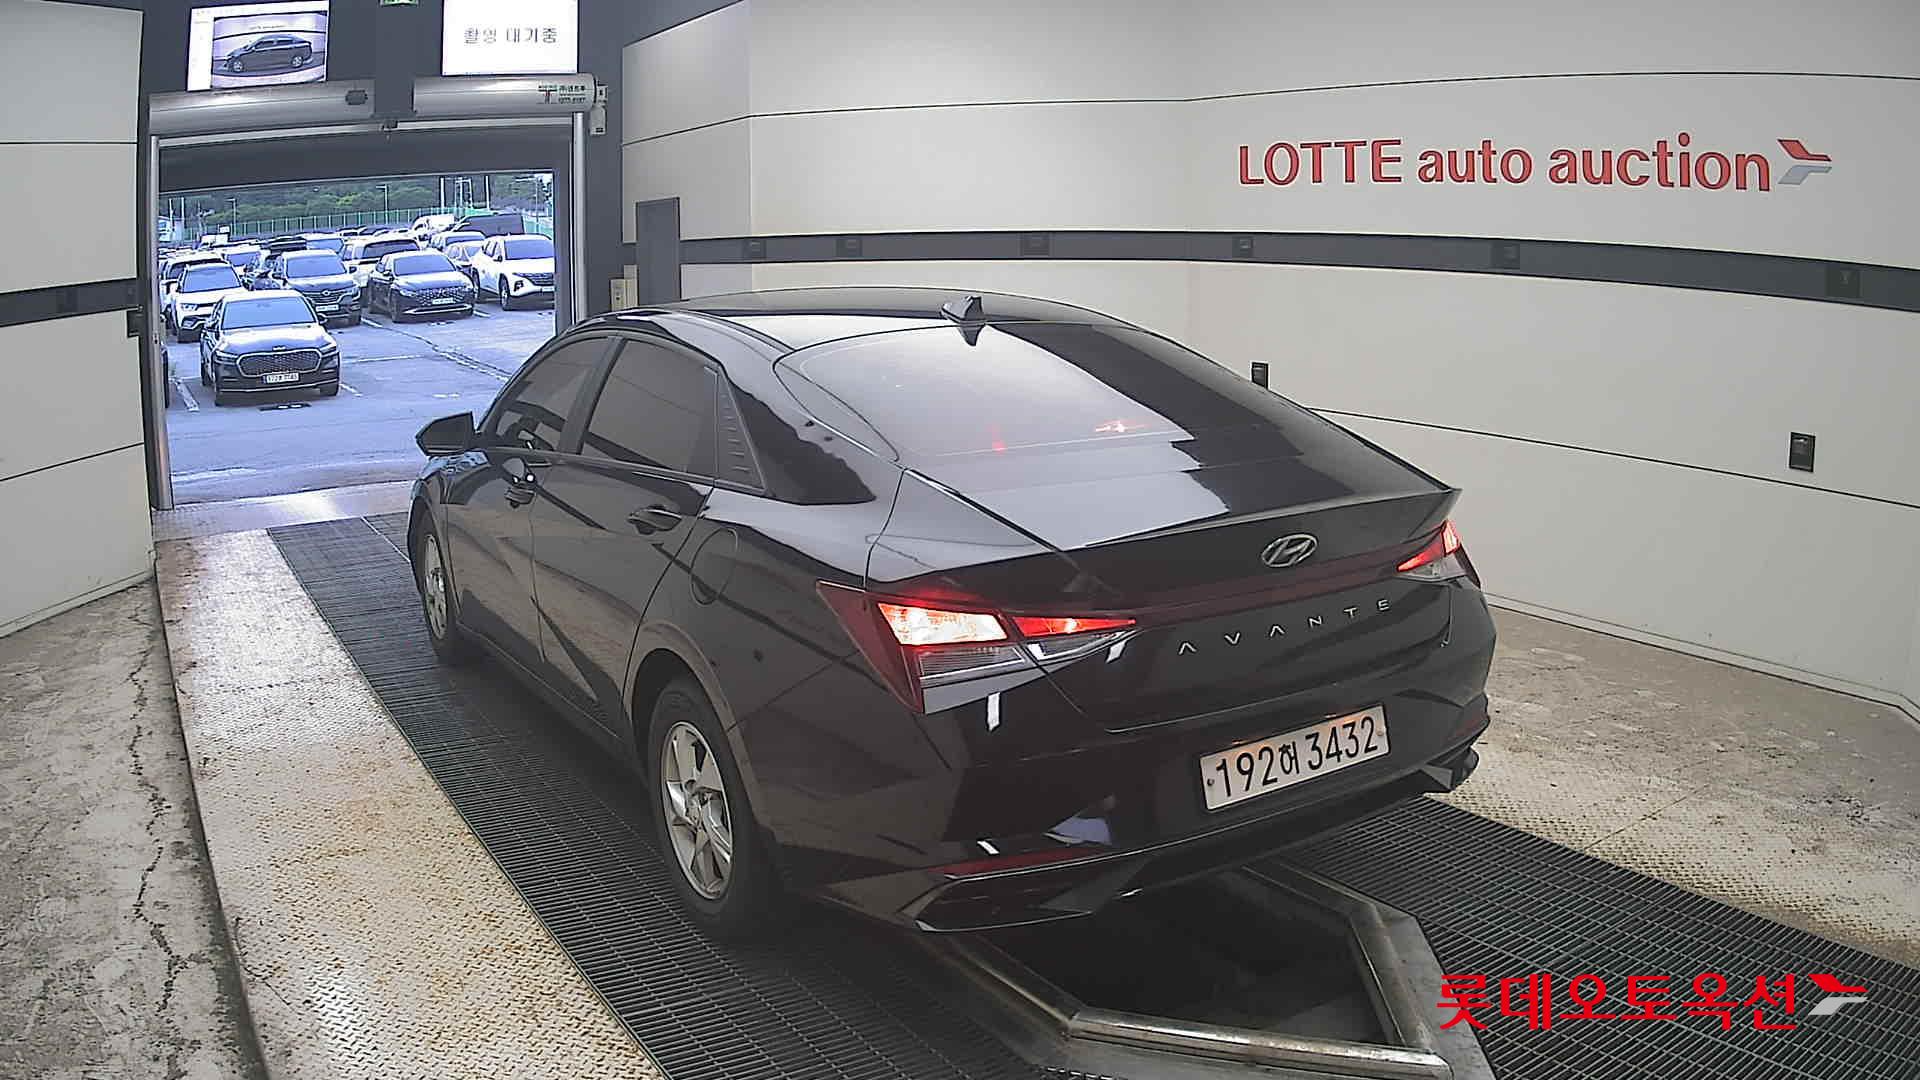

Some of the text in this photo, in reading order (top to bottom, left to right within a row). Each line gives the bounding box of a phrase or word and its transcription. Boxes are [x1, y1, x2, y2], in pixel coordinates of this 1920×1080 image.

[463, 27, 558, 44] 촬영 대기중
[1238, 132, 1772, 192] LOTTE auto auction
[1178, 599, 1390, 656] AVANTE
[1215, 715, 1379, 798] 192허 3432
